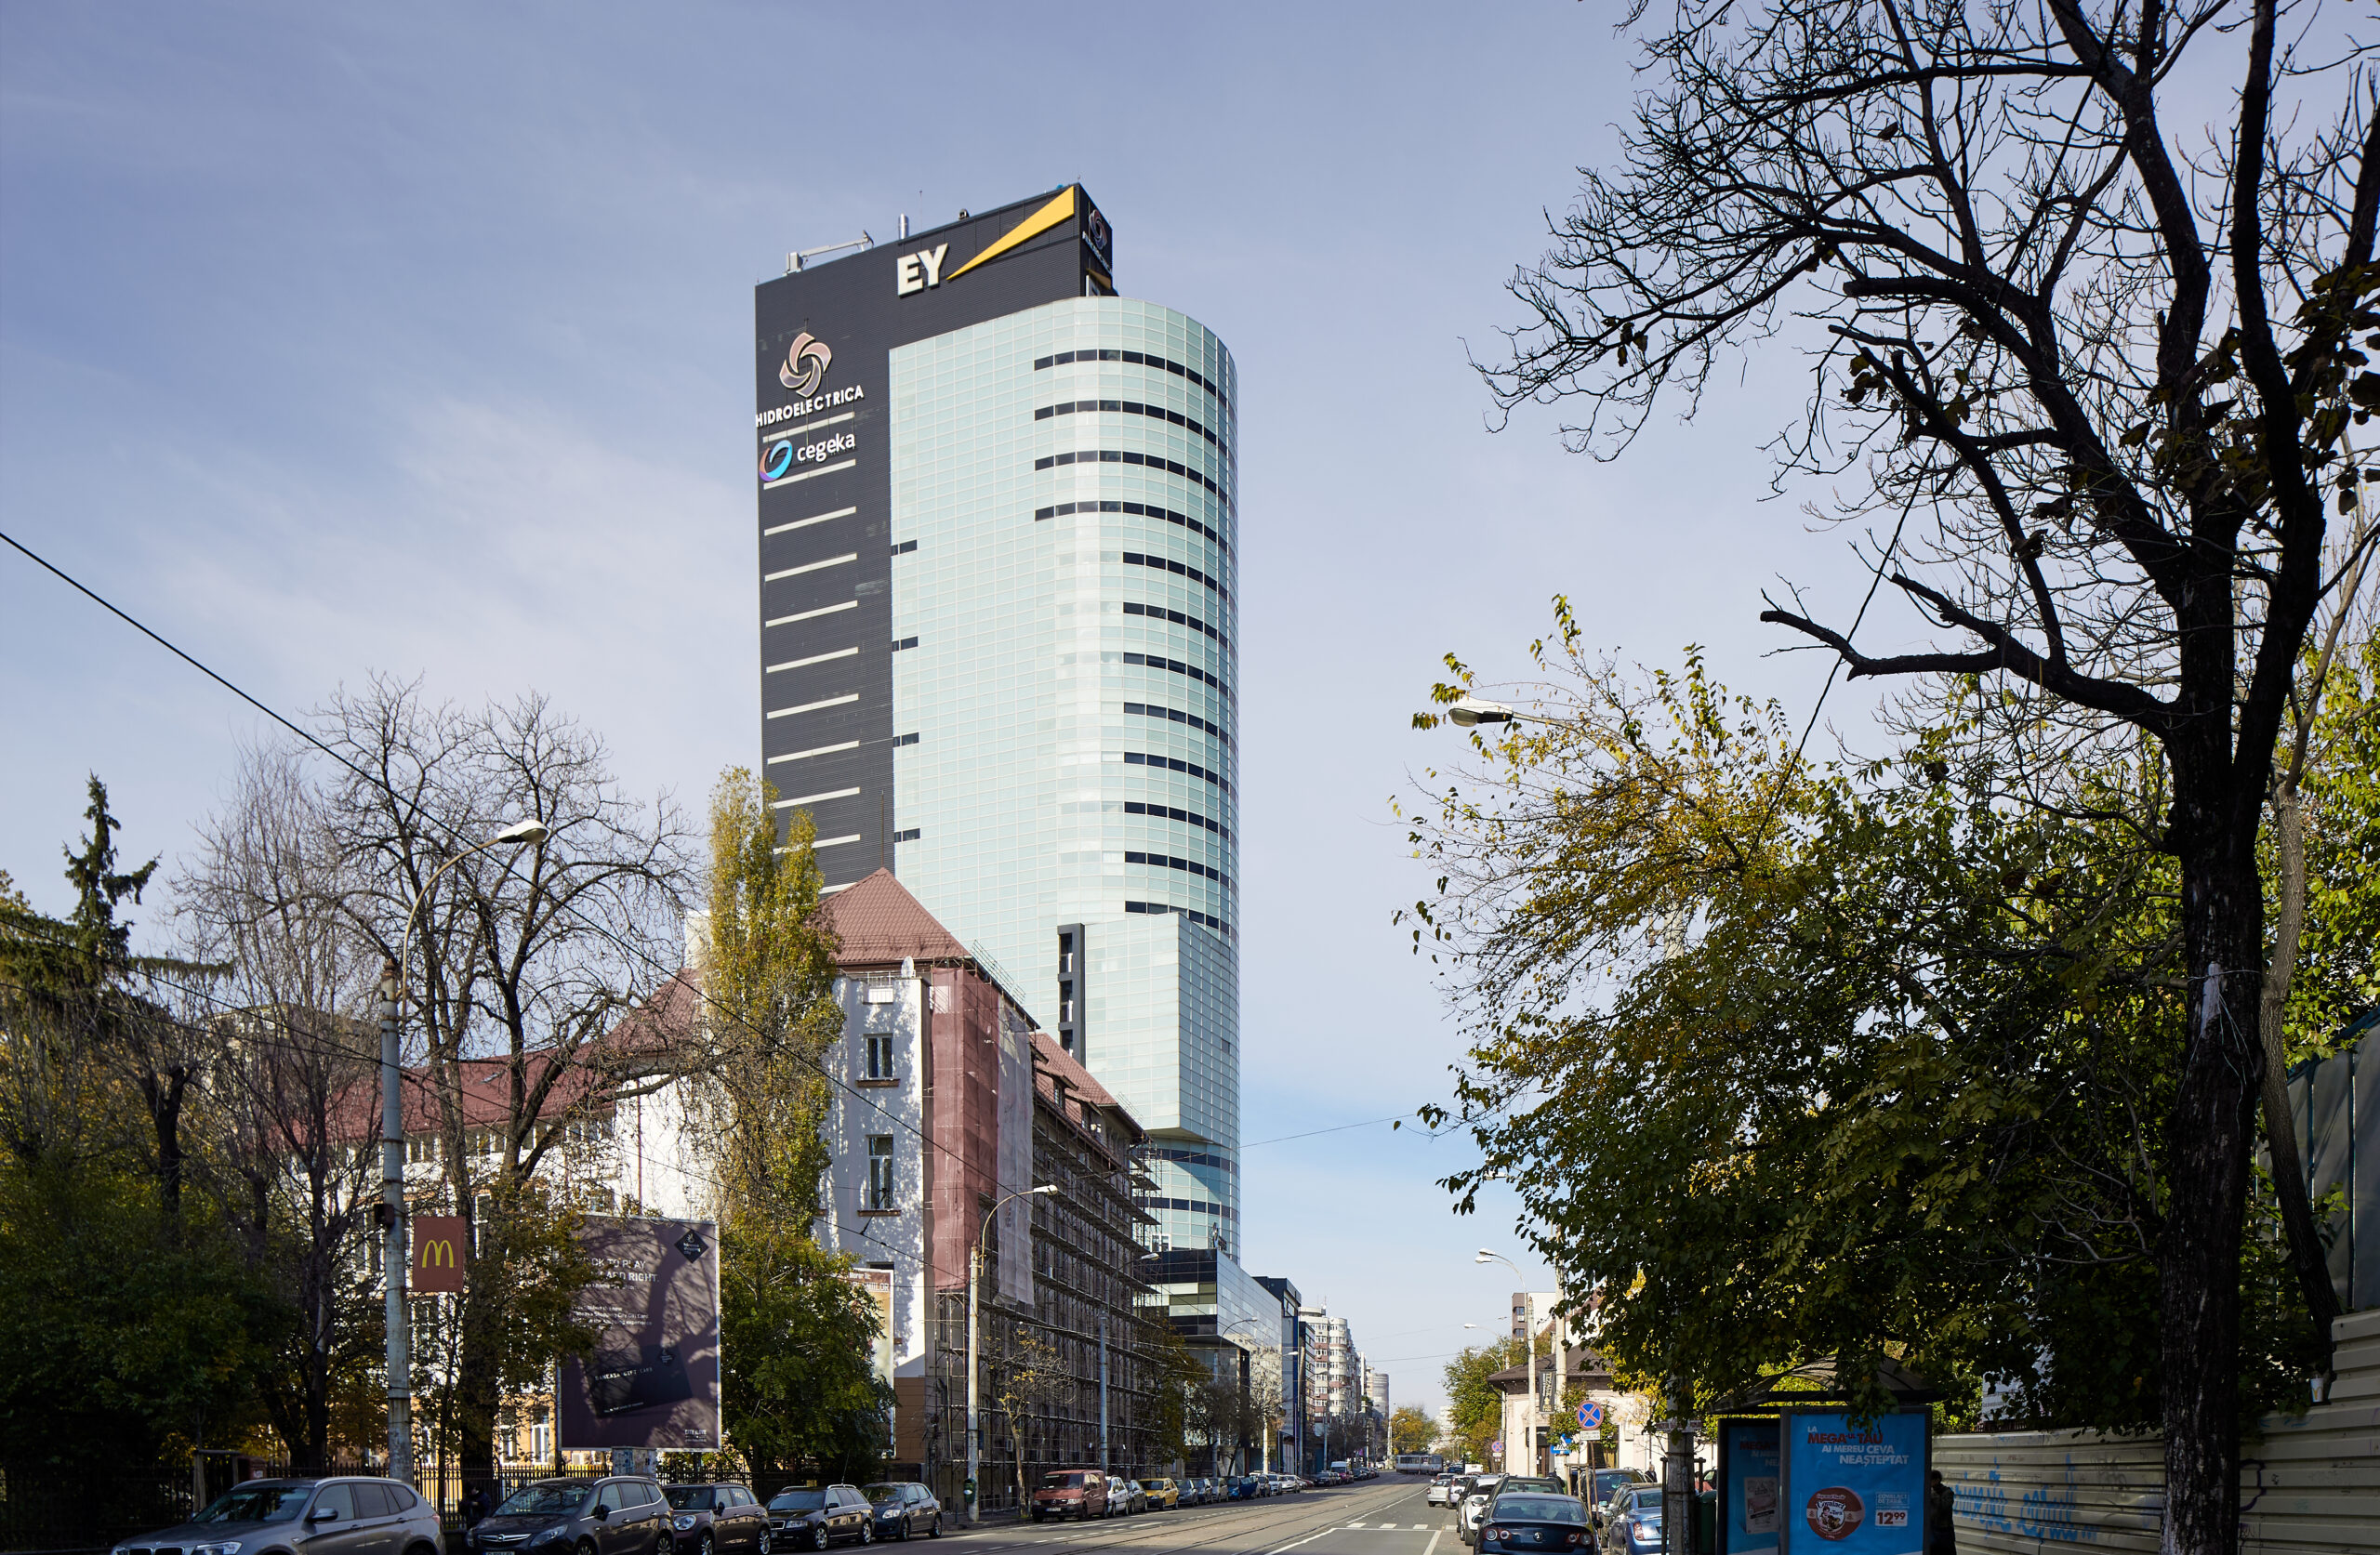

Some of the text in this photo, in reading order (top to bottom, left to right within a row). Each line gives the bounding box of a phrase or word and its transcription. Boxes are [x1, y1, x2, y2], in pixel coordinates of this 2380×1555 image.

[897, 243, 948, 296] EY
[755, 385, 864, 428] HIDROELECTRICA
[797, 433, 855, 462] cegeka
[1866, 1444, 1895, 1454] CEVA
